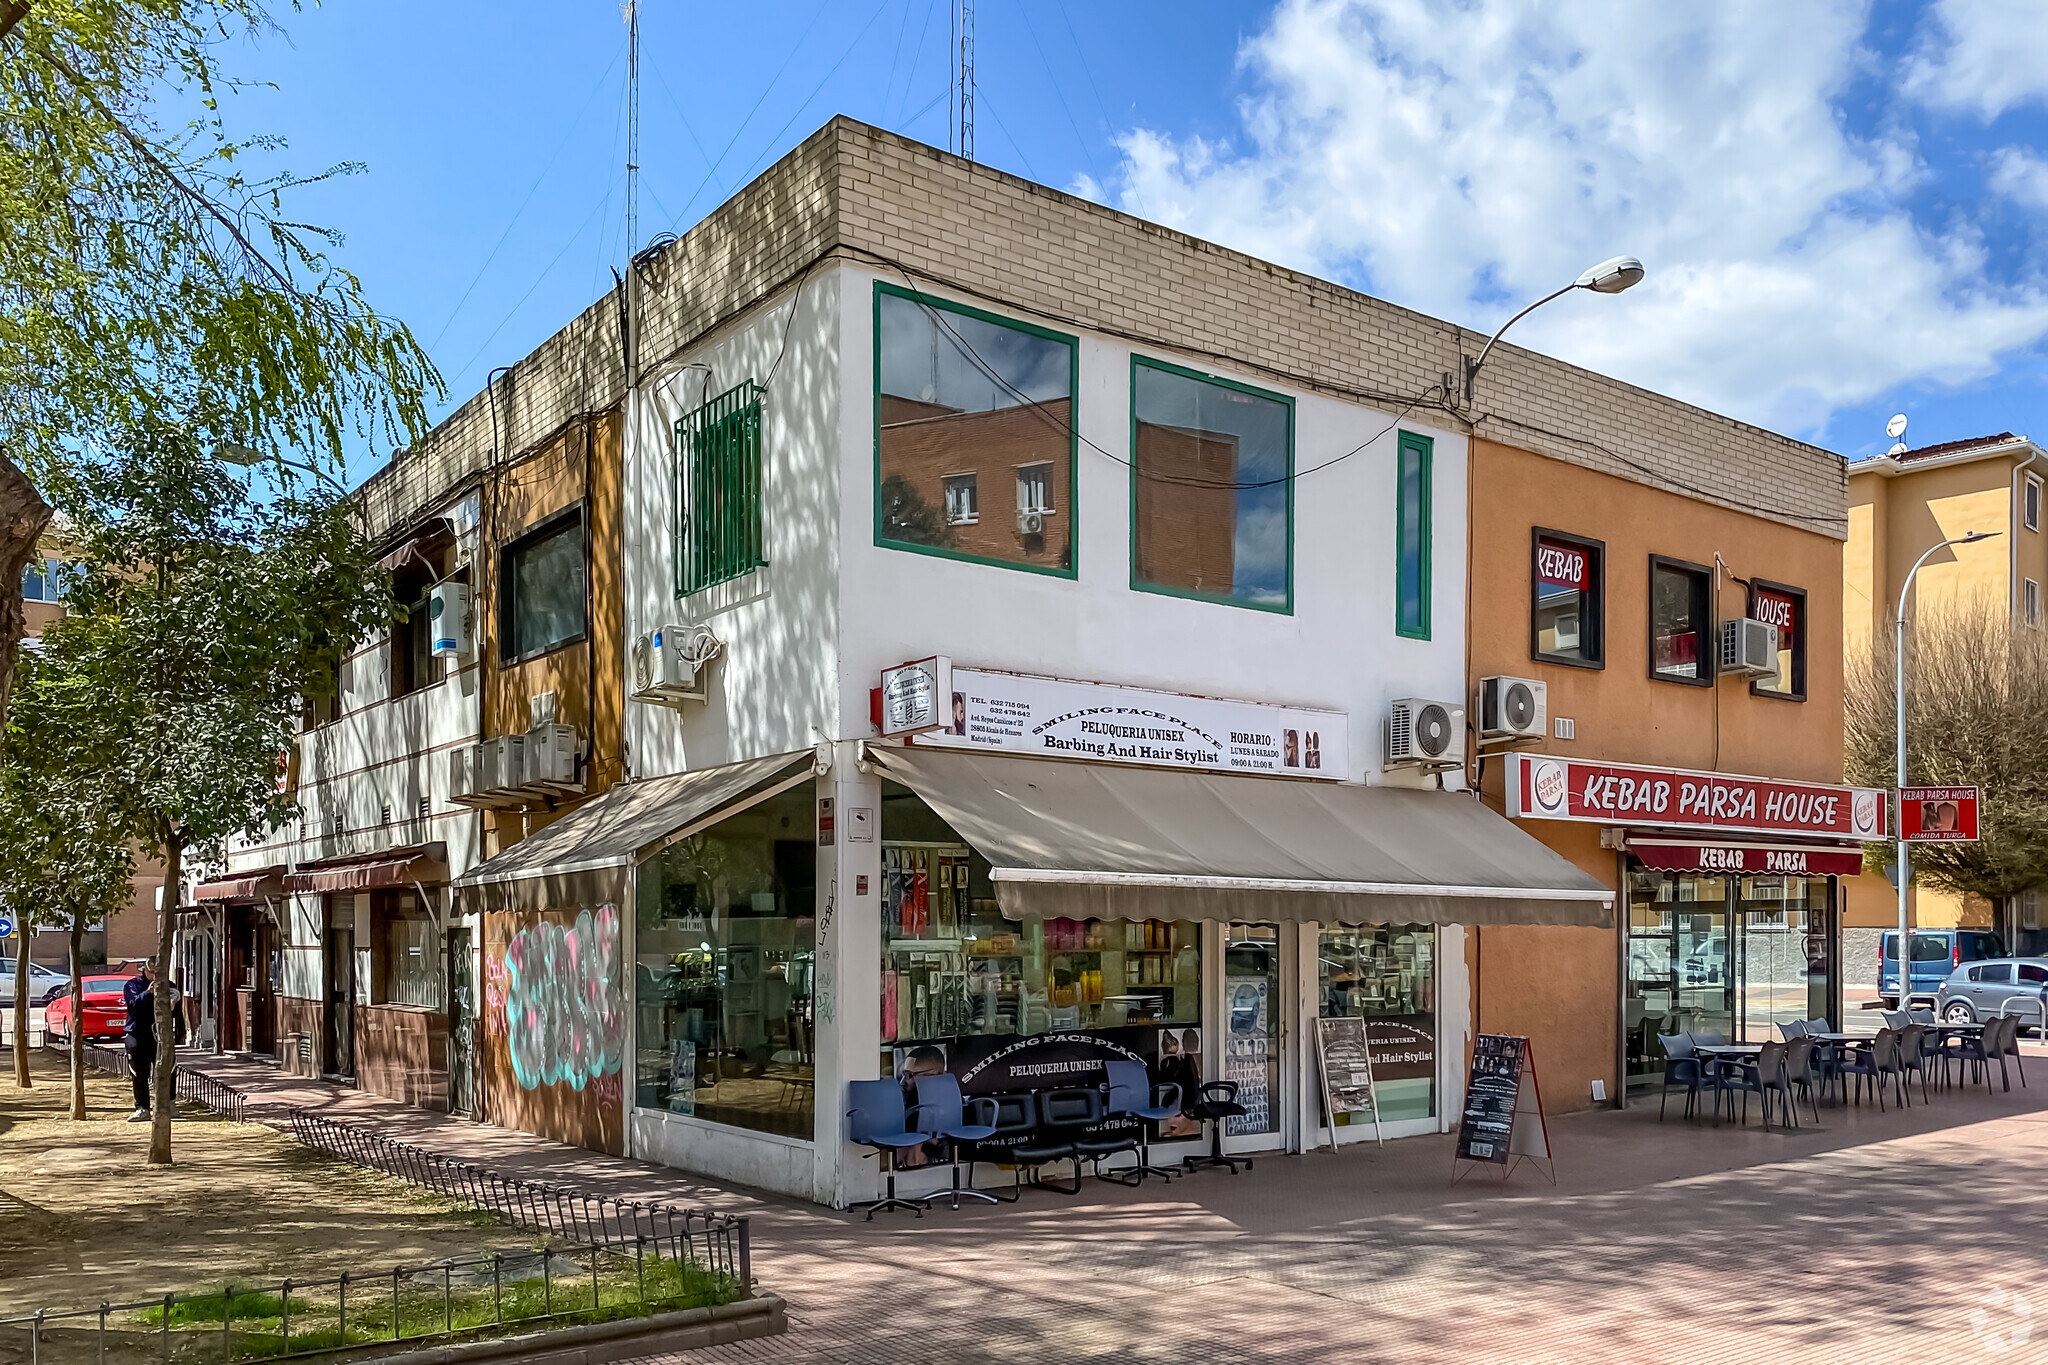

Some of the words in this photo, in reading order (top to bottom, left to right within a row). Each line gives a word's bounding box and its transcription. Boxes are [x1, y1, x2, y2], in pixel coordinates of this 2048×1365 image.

[1538, 547, 1584, 583] KEBAB
[989, 707, 1003, 715] 632
[990, 699, 1004, 707] 632
[1031, 706, 1114, 736] SMILING
[1116, 707, 1167, 720] FACE
[1168, 716, 1224, 750] PLACE
[1080, 720, 1147, 740] PELUQUERIA
[1148, 728, 1185, 742] UNISEX
[1043, 734, 1106, 758] Barbing
[1106, 742, 1137, 758] And
[1139, 745, 1173, 760] Hair
[1174, 748, 1220, 765] Stylist
[1230, 746, 1251, 756] LUNES
[1230, 758, 1247, 767] 09:00
[1253, 760, 1268, 769] 21:00
[1537, 770, 1562, 792] KEBAB
[1540, 780, 1563, 801] PARSA
[1582, 774, 1671, 814] KEBAB
[1678, 781, 1757, 821] PARSA
[1764, 790, 1839, 826] HOUSE
[1902, 790, 1925, 801] KEBAB
[1926, 789, 1950, 800] PARSA
[1951, 789, 1975, 800] HOUSE
[1699, 846, 1744, 869] KEBAB
[1765, 849, 1807, 871] PARSA
[1389, 1036, 1417, 1044] UNISEX
[1401, 1023, 1434, 1042] PLACE
[961, 1037, 1041, 1084] SMILING
[1043, 1034, 1092, 1044] FACE
[1382, 1054, 1404, 1064] Hair
[1404, 1050, 1433, 1063] Stylist
[1009, 1061, 1069, 1078] PELUQUERIA
[1070, 1059, 1103, 1072] UNISEX
[1103, 1119, 1120, 1129] 478
